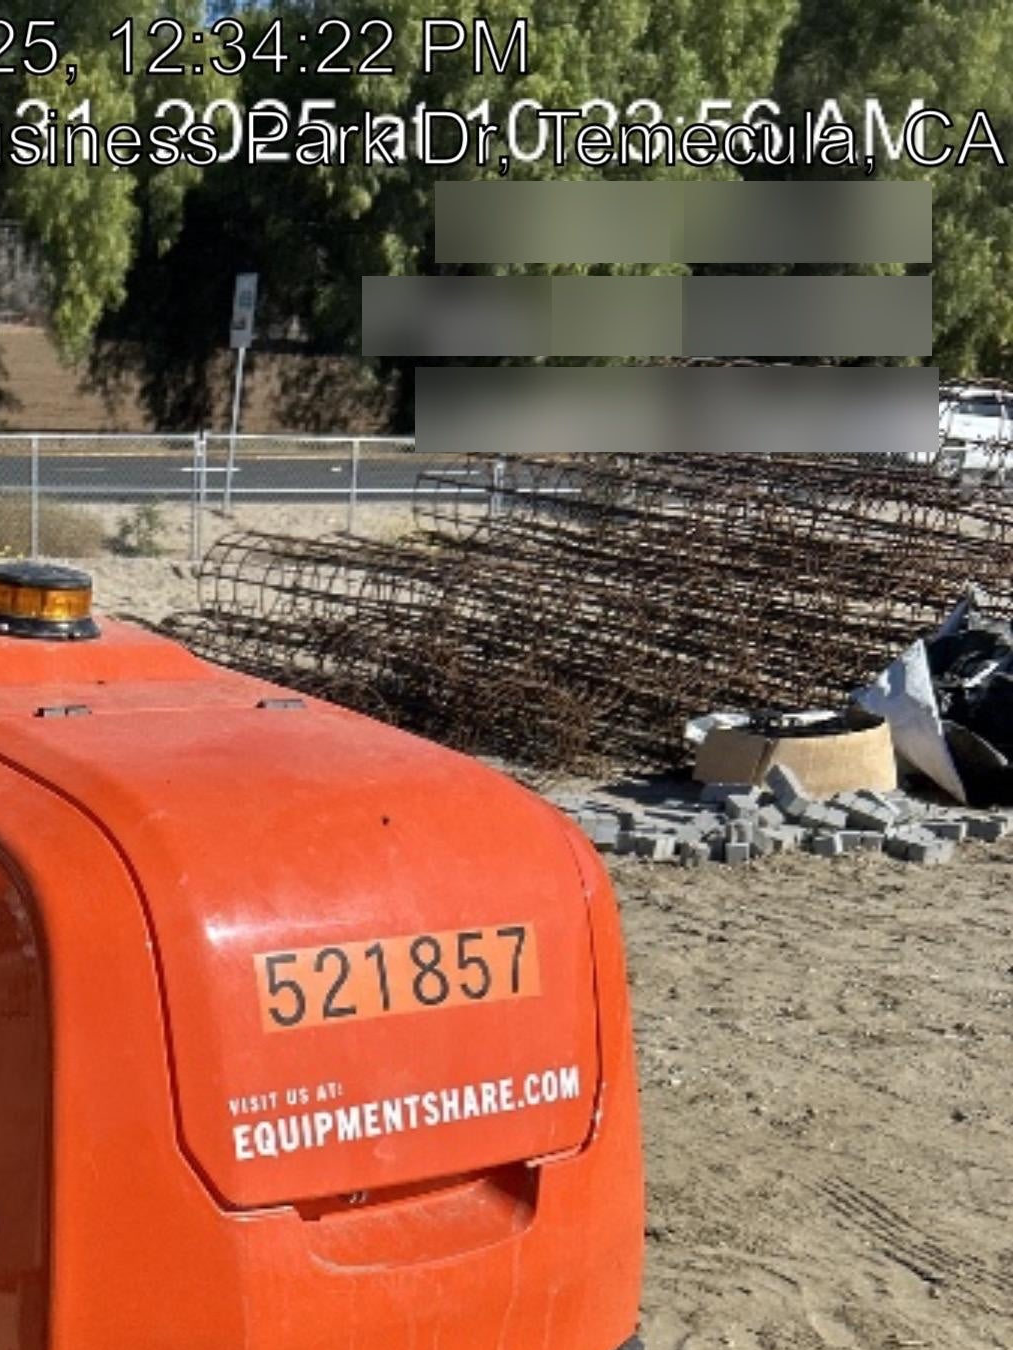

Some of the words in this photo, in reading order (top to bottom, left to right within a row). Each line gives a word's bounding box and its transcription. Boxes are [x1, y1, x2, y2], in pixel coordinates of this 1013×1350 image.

[264, 926, 526, 1027] 521857
[228, 1091, 278, 1117] VISIT
[286, 1085, 310, 1106] US
[315, 1081, 343, 1102] AT:
[232, 1065, 581, 1161] EQUIPMENTSHARE.COM
